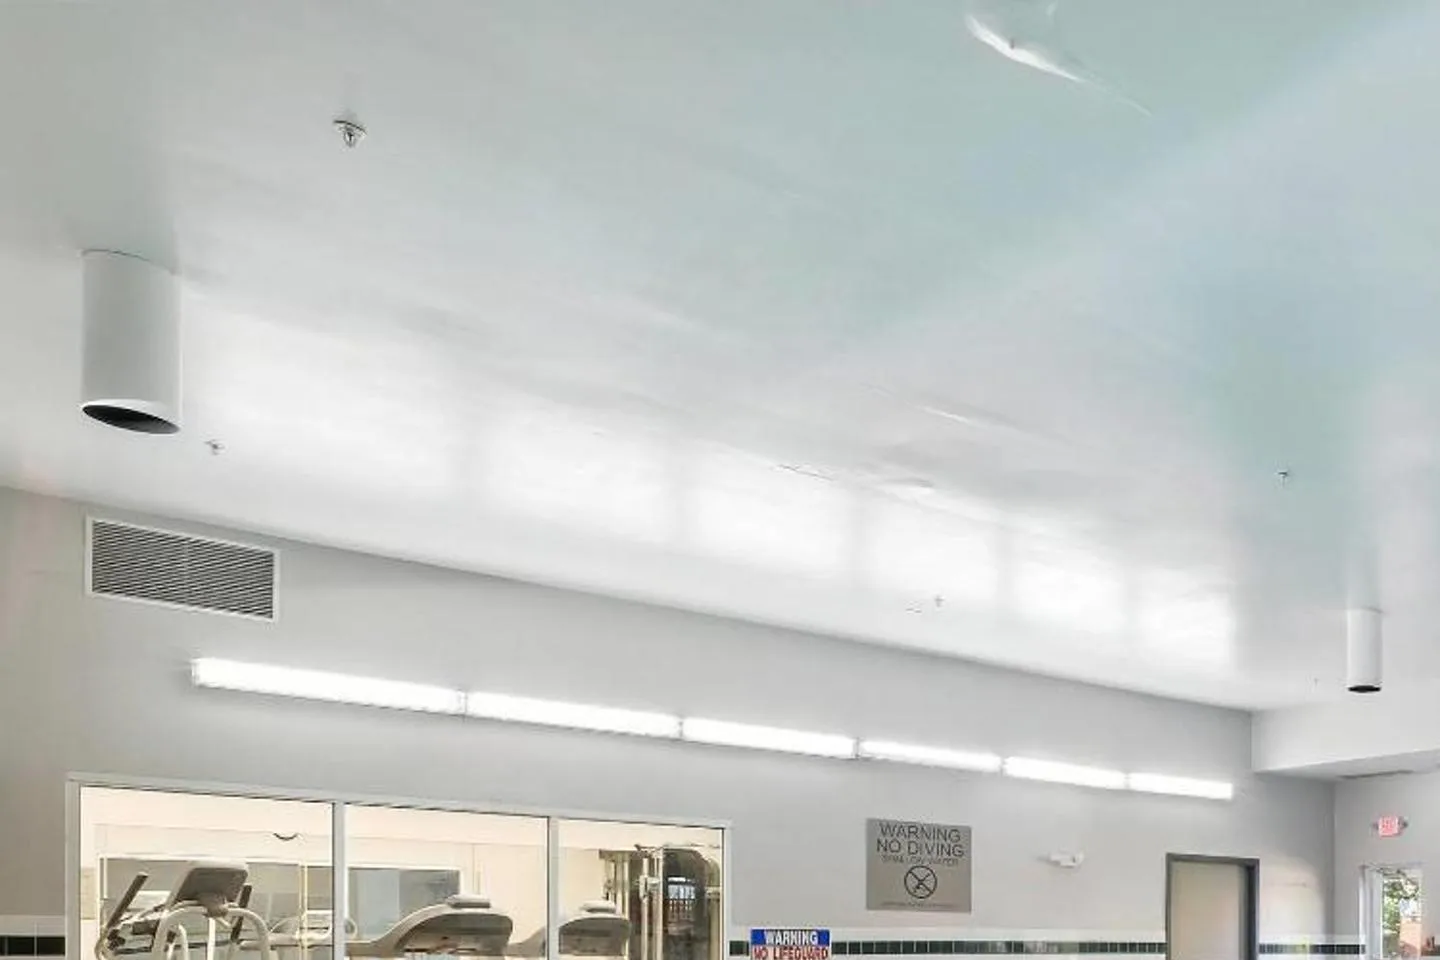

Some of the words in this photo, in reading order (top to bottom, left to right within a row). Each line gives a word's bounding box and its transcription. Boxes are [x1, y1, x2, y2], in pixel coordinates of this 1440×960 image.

[879, 821, 961, 843] WARNING
[876, 838, 901, 853] NO
[907, 840, 965, 858] DIVING
[766, 930, 819, 946] WARNING
